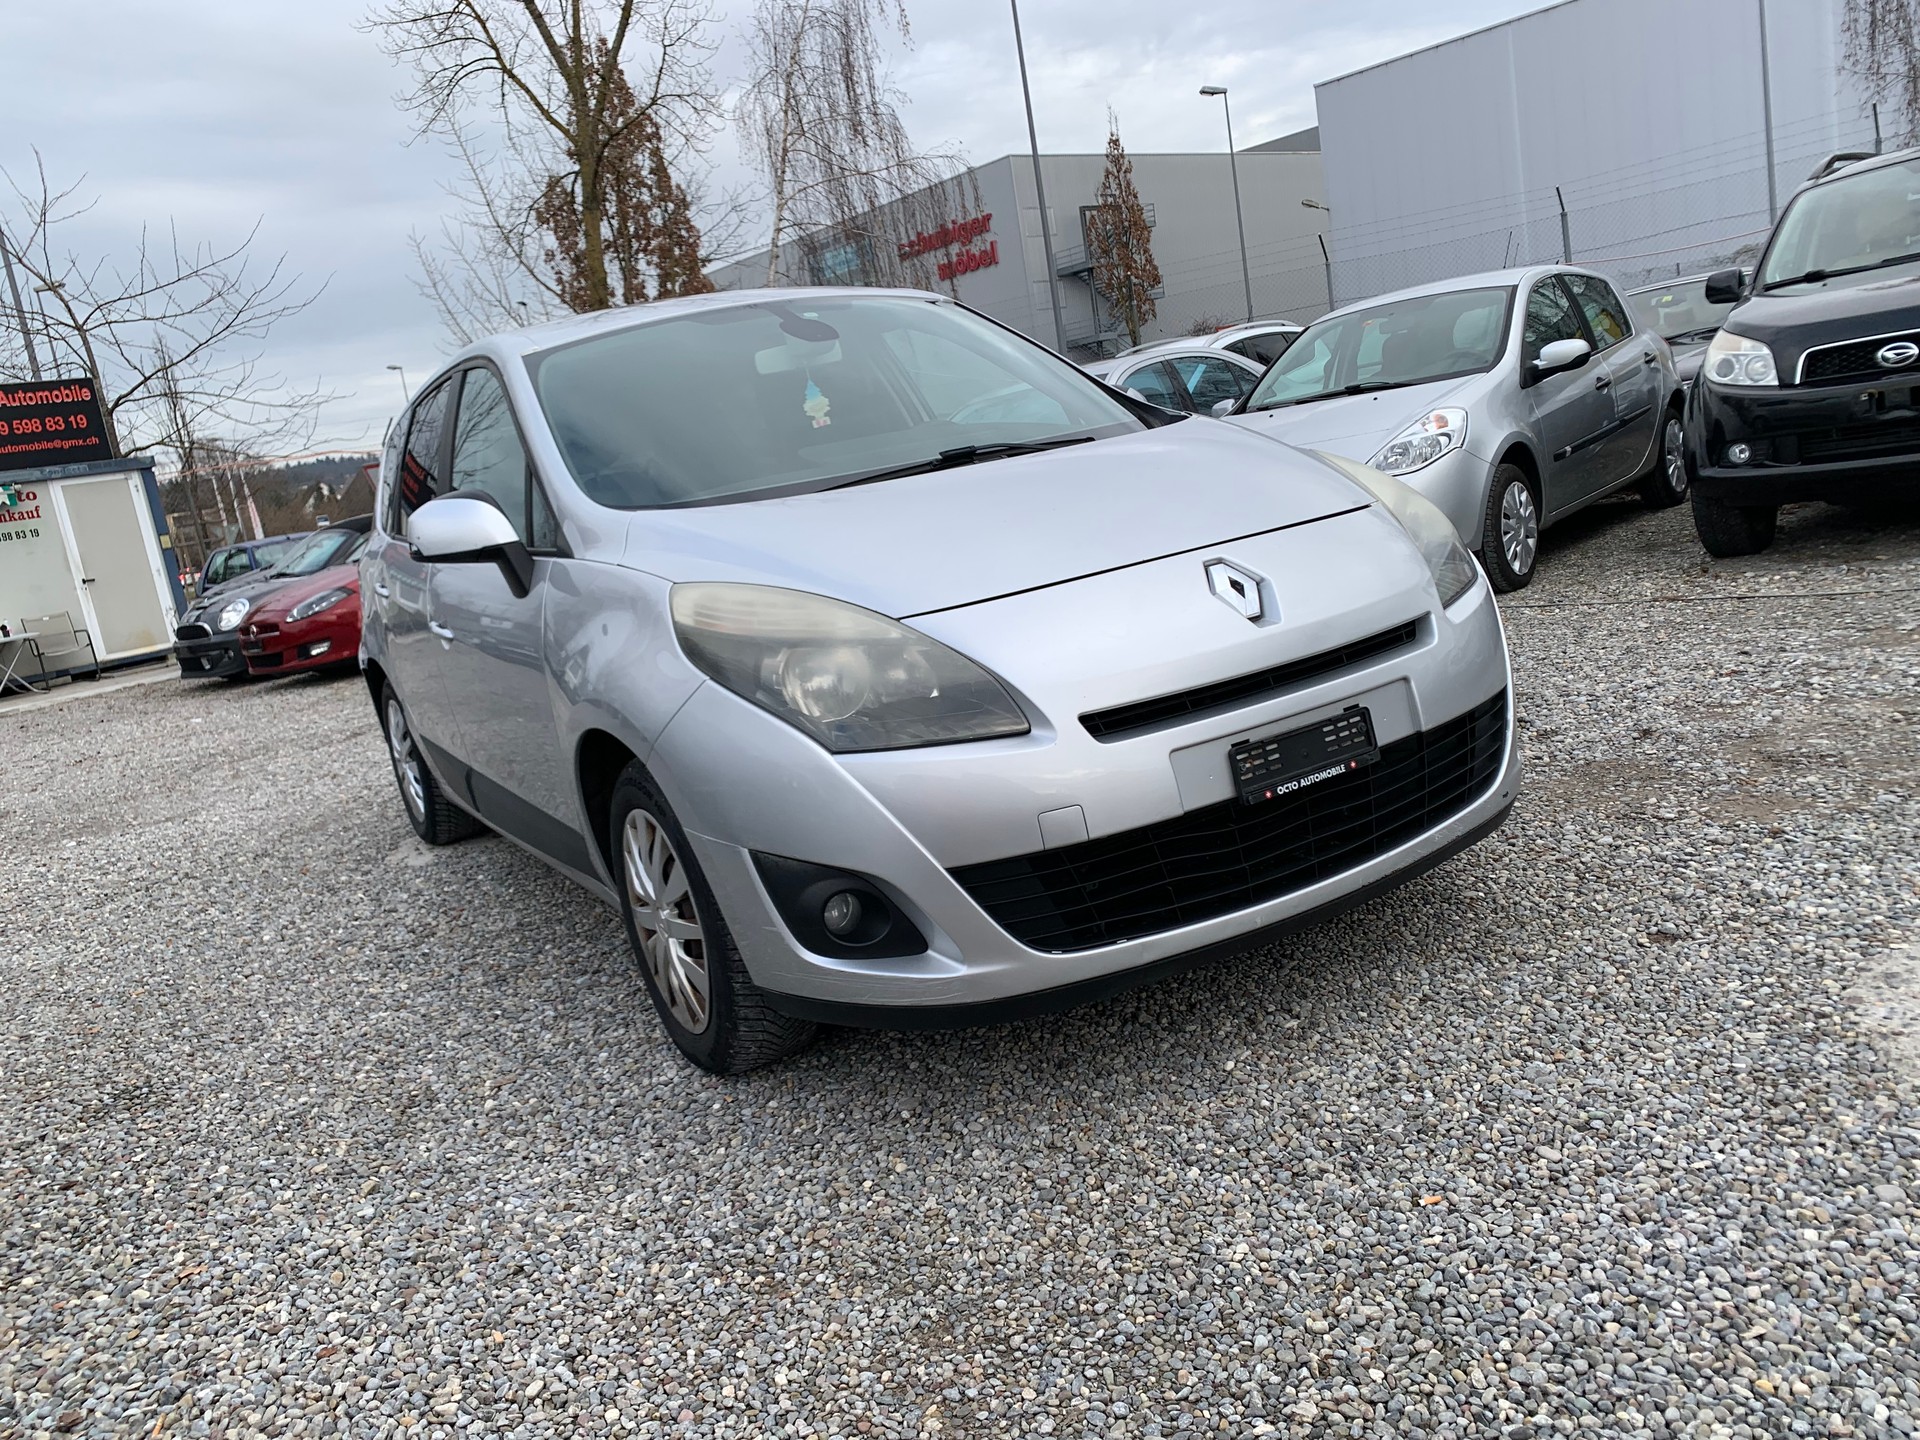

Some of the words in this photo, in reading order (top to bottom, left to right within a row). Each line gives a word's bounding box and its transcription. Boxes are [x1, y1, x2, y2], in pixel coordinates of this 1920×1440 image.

[937, 241, 999, 281] möbel
[0, 384, 91, 407] Automobile
[13, 418, 42, 434] 598
[45, 416, 65, 431] 83
[68, 414, 88, 429] 19
[0, 436, 99, 453] utomobile@gmx.ch
[17, 490, 38, 502] to
[0, 532, 13, 542] 98
[15, 530, 27, 540] 83
[29, 528, 40, 538] 19
[1277, 781, 1299, 795] OCTO
[1300, 764, 1346, 787] AUTOMOBILE
